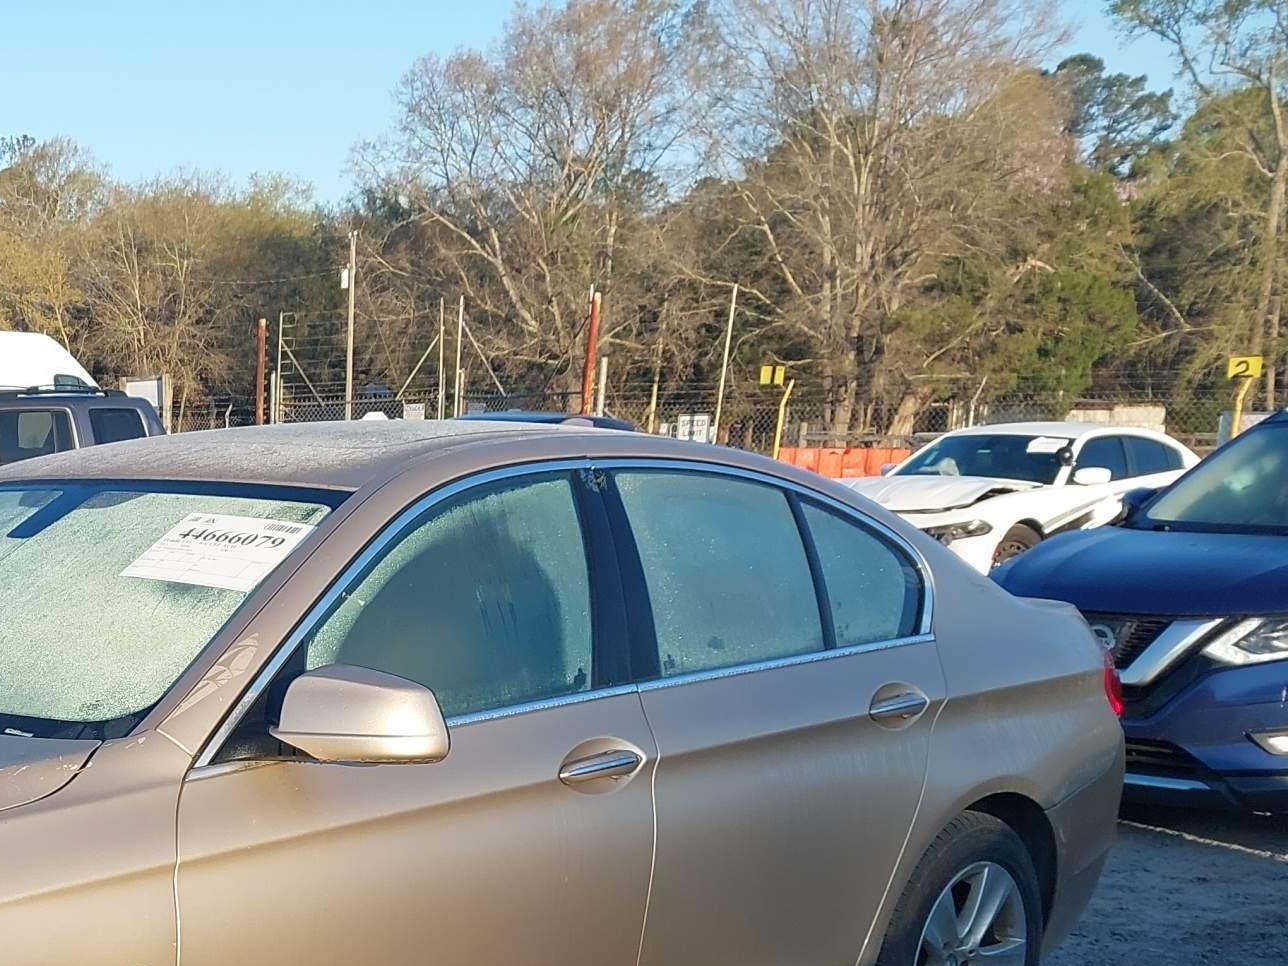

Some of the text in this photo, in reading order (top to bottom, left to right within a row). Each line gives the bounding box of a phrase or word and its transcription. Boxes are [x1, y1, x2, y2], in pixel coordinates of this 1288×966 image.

[1232, 360, 1254, 378] 2
[681, 419, 707, 427] SPEED
[178, 526, 286, 548] 44666079
